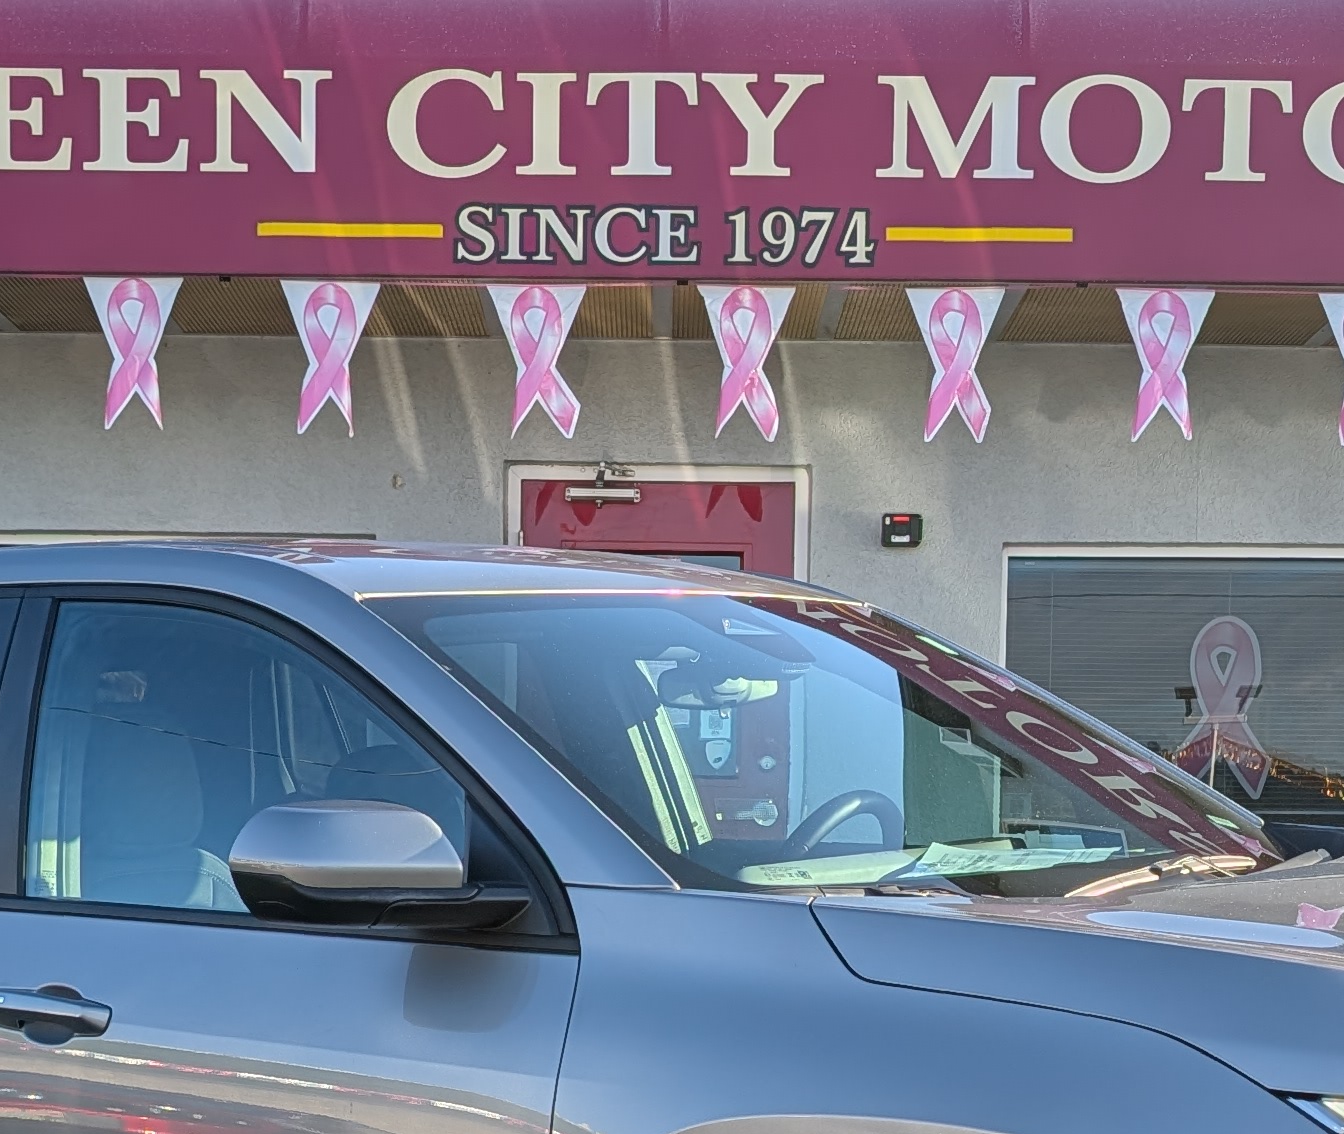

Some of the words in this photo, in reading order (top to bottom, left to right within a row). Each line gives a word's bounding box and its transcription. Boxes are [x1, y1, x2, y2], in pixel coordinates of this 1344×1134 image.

[385, 70, 825, 179] CITY
[455, 204, 700, 265] SINCE
[724, 206, 876, 268] 1974
